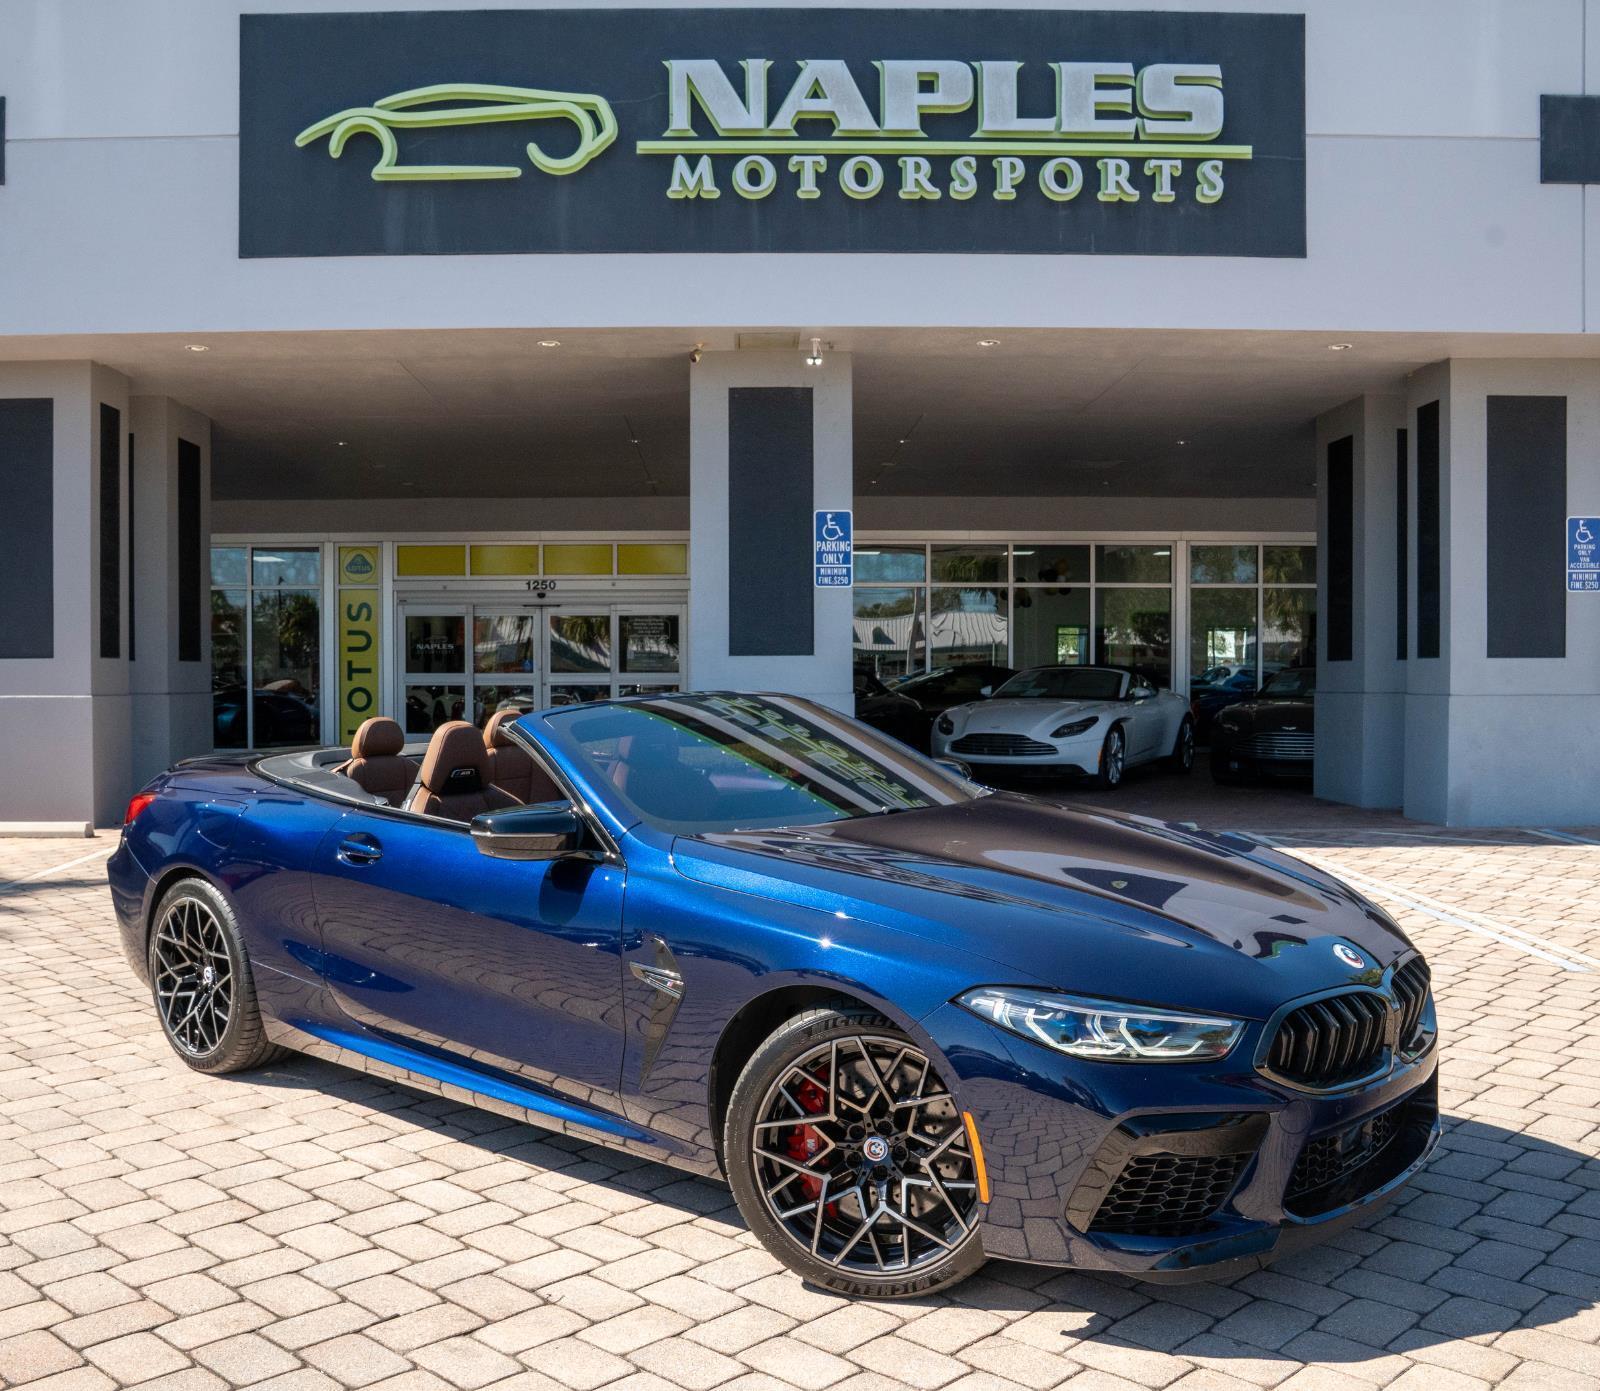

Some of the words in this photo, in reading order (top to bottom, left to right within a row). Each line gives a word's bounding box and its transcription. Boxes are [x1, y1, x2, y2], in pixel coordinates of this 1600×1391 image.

[662, 58, 1224, 141] NAPLES
[666, 154, 1225, 203] MOTORSPORTS
[816, 541, 850, 552] PARKING
[822, 553, 844, 564] ONLY
[820, 567, 847, 576] MINIMUM
[526, 580, 556, 591] 1250
[347, 602, 372, 735] OTUS
[832, 1279, 931, 1296] MICHELIN
